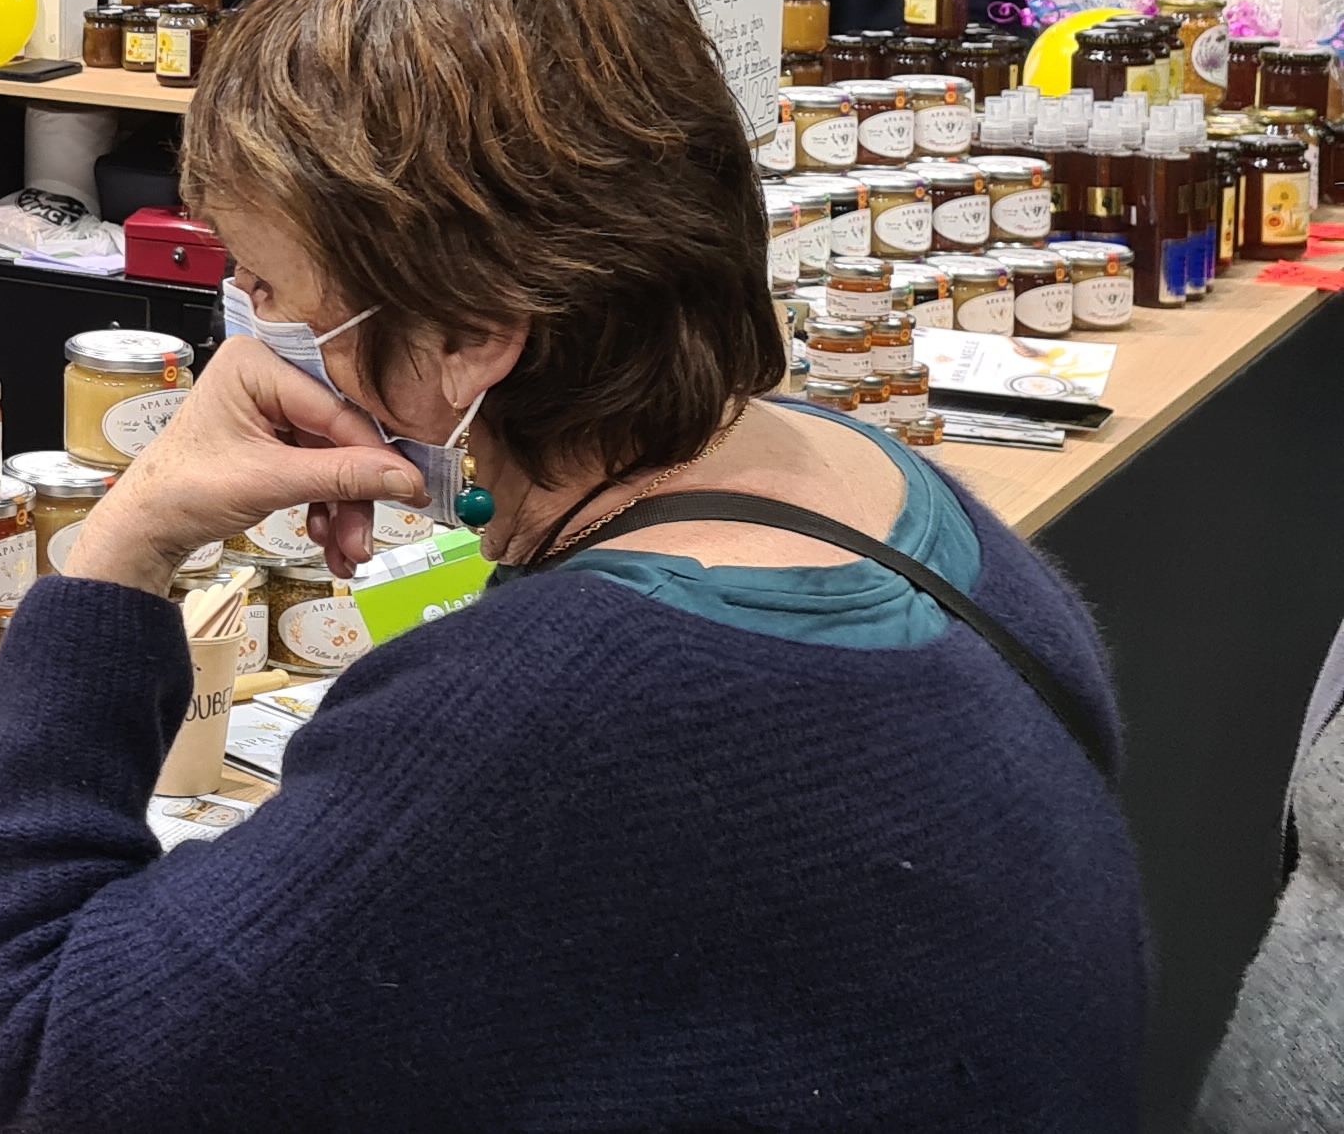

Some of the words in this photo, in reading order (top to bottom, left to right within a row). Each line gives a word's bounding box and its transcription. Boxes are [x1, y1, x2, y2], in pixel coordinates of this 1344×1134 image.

[139, 399, 161, 411] APA
[311, 602, 333, 613] APA
[188, 688, 231, 722] OUBE
